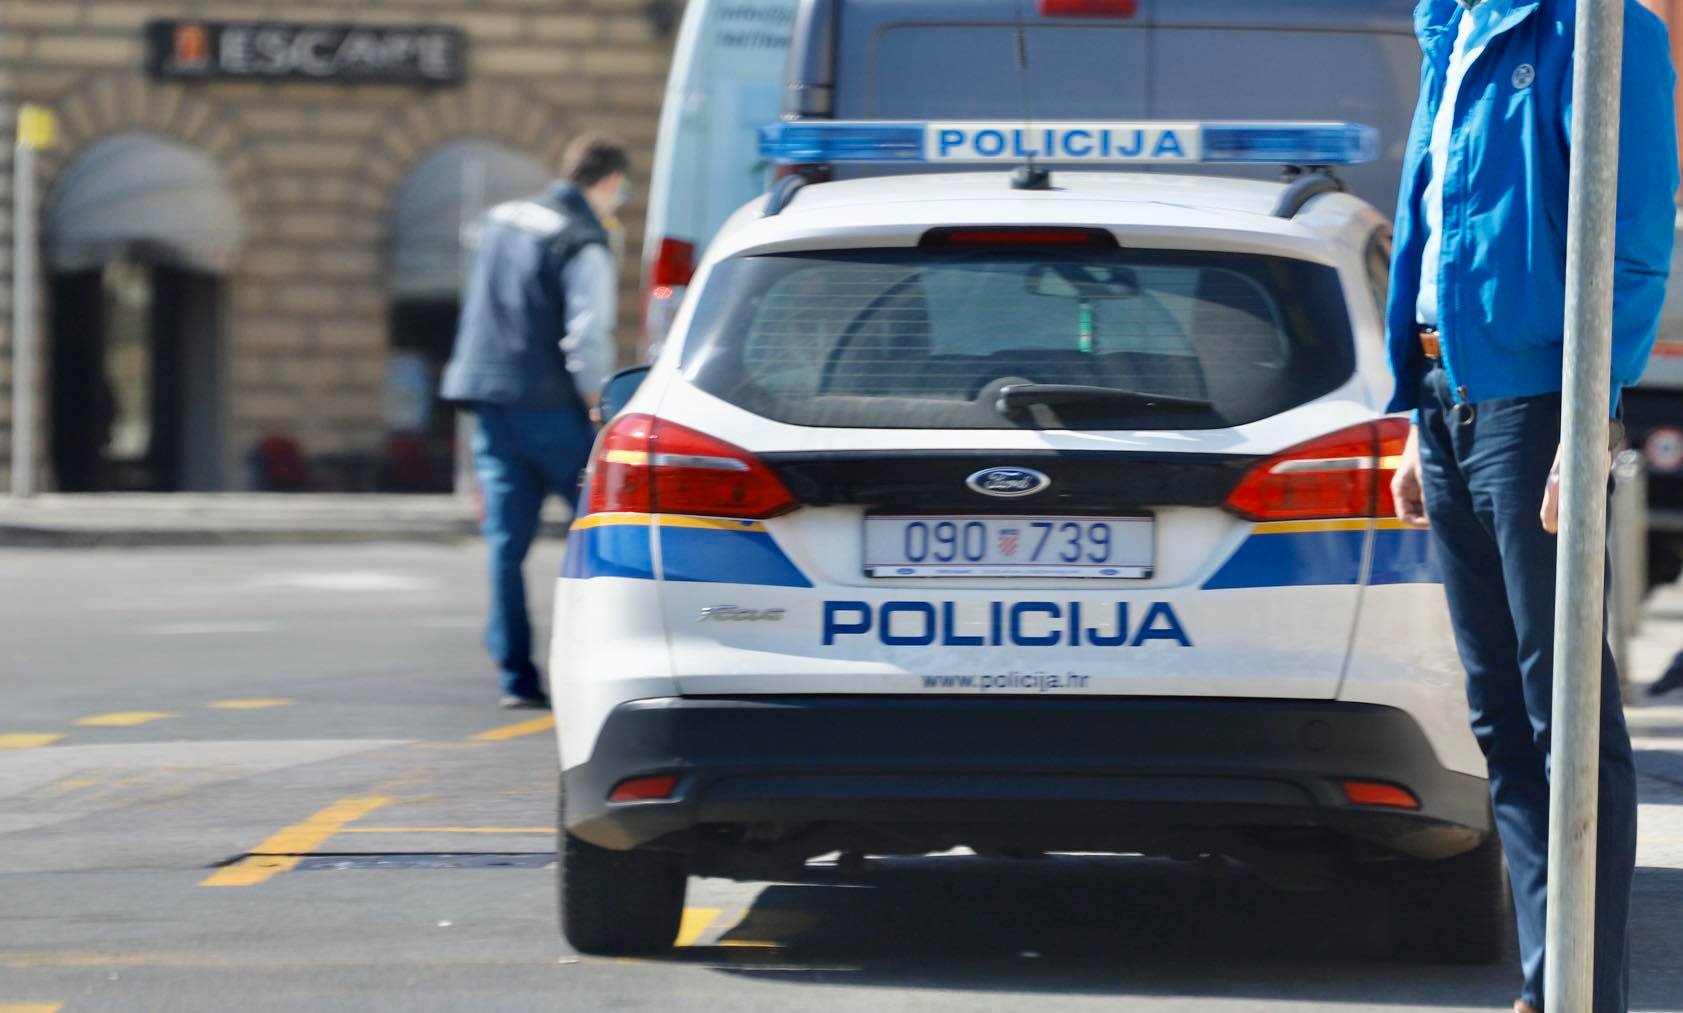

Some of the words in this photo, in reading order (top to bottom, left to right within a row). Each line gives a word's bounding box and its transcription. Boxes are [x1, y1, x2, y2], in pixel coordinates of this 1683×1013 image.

[218, 25, 455, 79] ESCAPE
[938, 128, 1185, 158] POLICIJA
[984, 470, 1032, 489] Ford
[904, 521, 986, 562] 090
[1030, 521, 1111, 563] 739
[821, 600, 1193, 647] POLICIJA
[922, 671, 1091, 692] www.policija.hr
